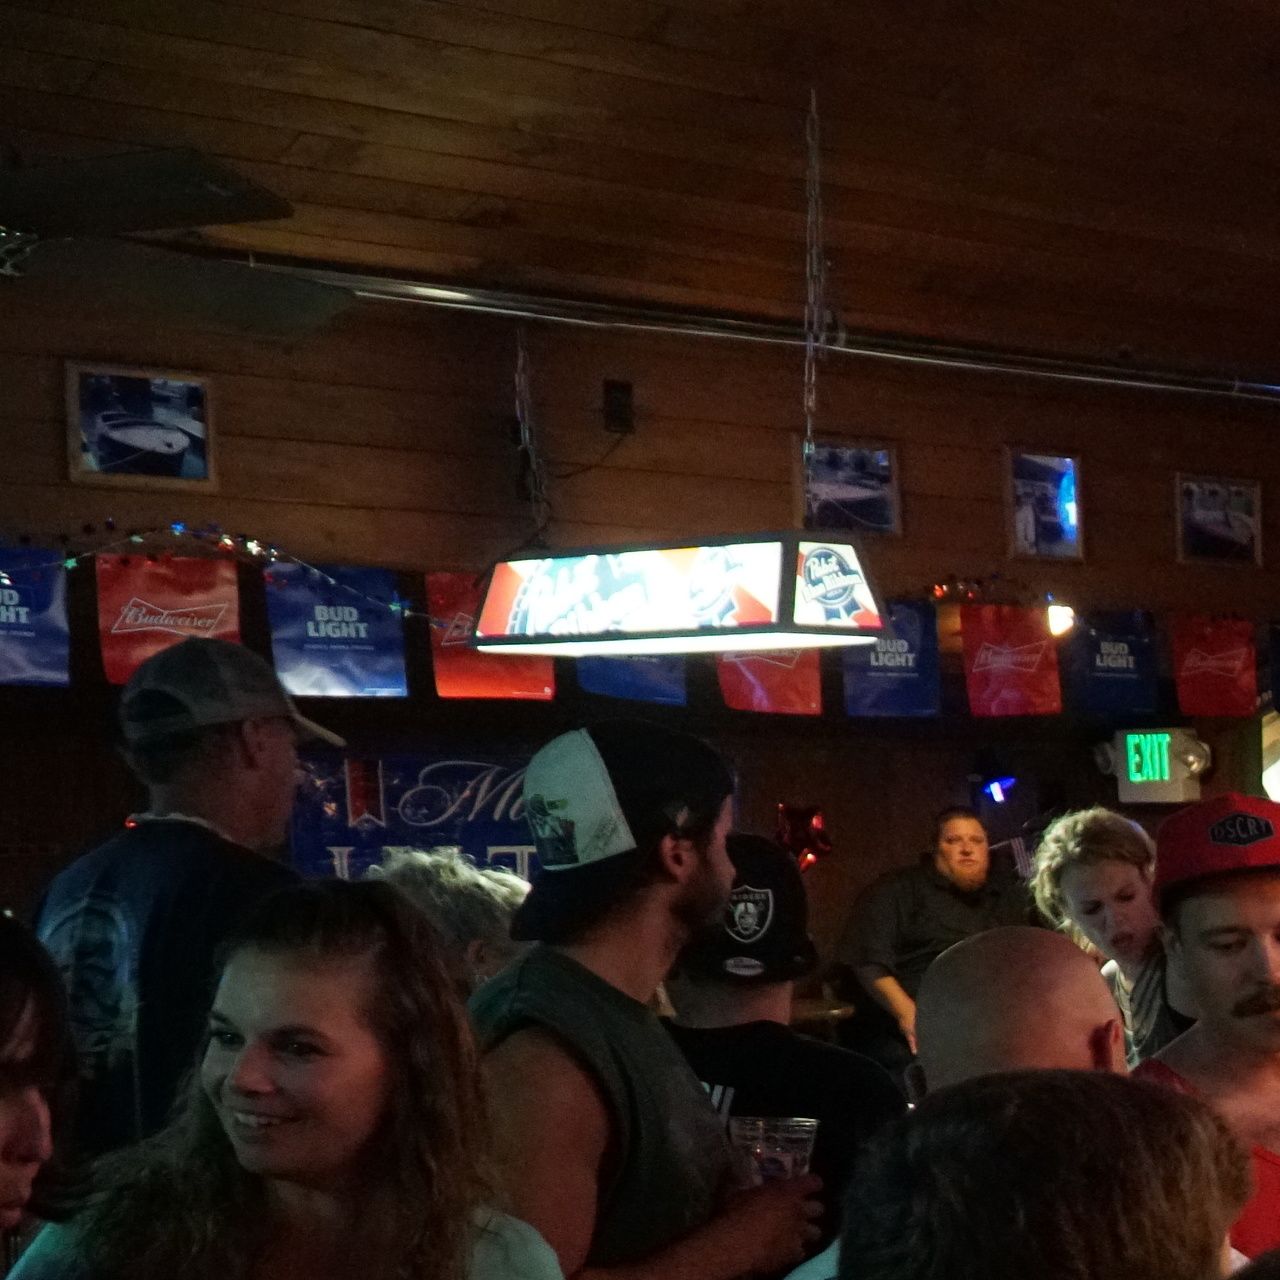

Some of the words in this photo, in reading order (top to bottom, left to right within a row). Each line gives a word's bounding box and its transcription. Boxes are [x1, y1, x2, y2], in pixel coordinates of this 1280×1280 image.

[121, 604, 218, 629] Budweiser
[313, 605, 358, 622] BUD
[305, 621, 370, 639] LIGHT
[877, 639, 909, 653] BUD
[1100, 641, 1130, 655] BUD
[870, 652, 916, 667] LIGHT
[1095, 653, 1137, 669] LIGHT
[1126, 733, 1171, 783] EXIT
